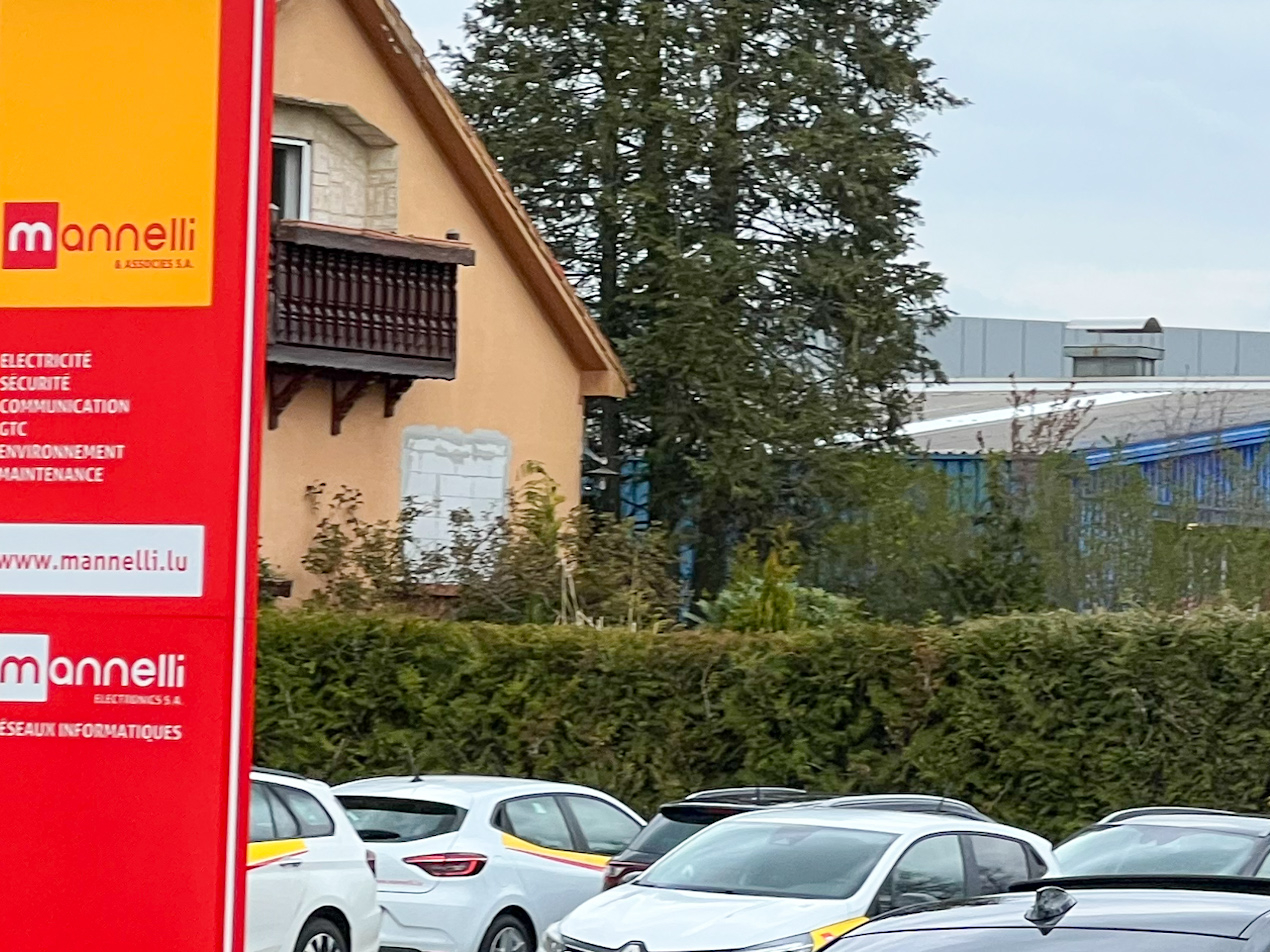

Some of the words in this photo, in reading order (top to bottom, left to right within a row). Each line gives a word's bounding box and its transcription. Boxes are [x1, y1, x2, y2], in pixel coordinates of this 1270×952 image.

[8, 217, 195, 252] mannelli
[0, 373, 71, 391] SÉCURITÉ
[0, 399, 130, 414] COMMUNICATION
[0, 421, 27, 437] GTC
[0, 444, 125, 459] ENVIRONNEMENT
[0, 550, 188, 572] www.mannelli.lu
[1, 654, 185, 687] mannelli
[94, 694, 162, 706] ELECTRONICS
[0, 718, 56, 737] ÉSEAUX
[58, 723, 182, 742] INFORMATIQUES
